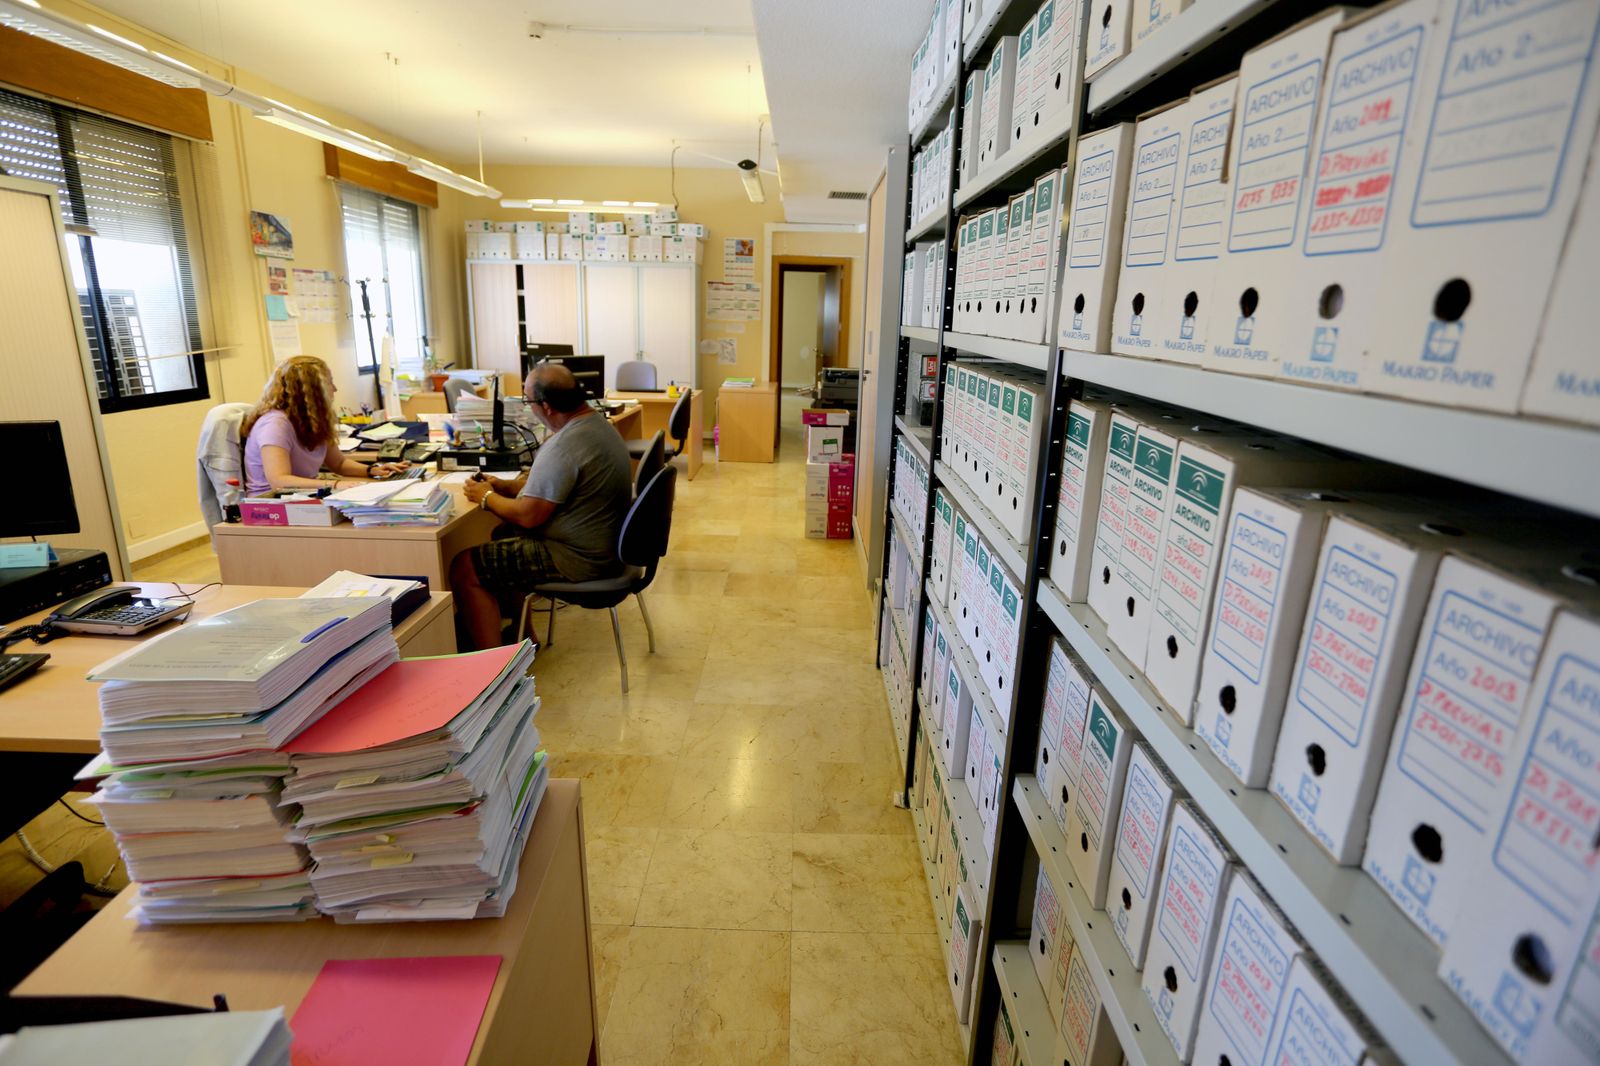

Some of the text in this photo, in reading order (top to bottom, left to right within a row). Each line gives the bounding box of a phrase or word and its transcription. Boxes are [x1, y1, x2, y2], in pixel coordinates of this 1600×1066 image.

[1339, 47, 1415, 89] ARCHIVO
[1454, 46, 1503, 77] Año
[1249, 75, 1316, 115] ARCHIVO
[1331, 113, 1358, 135] Año
[1245, 128, 1283, 151] Año 2
[1140, 143, 1178, 165] ARCHIVO
[1081, 159, 1112, 179] ARCHIVO
[1189, 158, 1218, 177] Año 2
[1080, 190, 1092, 202] Año
[1137, 180, 1151, 193] Año
[1439, 366, 1496, 389] PAPER
[1134, 478, 1163, 502] ARCHIVO
[1175, 503, 1212, 532] ARCHIVO
[1236, 526, 1283, 560] ARCHIVO
[1231, 558, 1249, 578] Año
[1329, 561, 1390, 605] ARCHIVO
[1323, 597, 1346, 621] Año
[1445, 608, 1538, 668] ARCHIVO
[1434, 651, 1519, 704] Año 2013
[1546, 727, 1596, 770] Año
[1177, 837, 1215, 888] ARCHIVO
[1235, 911, 1285, 977] ARCHIVO
